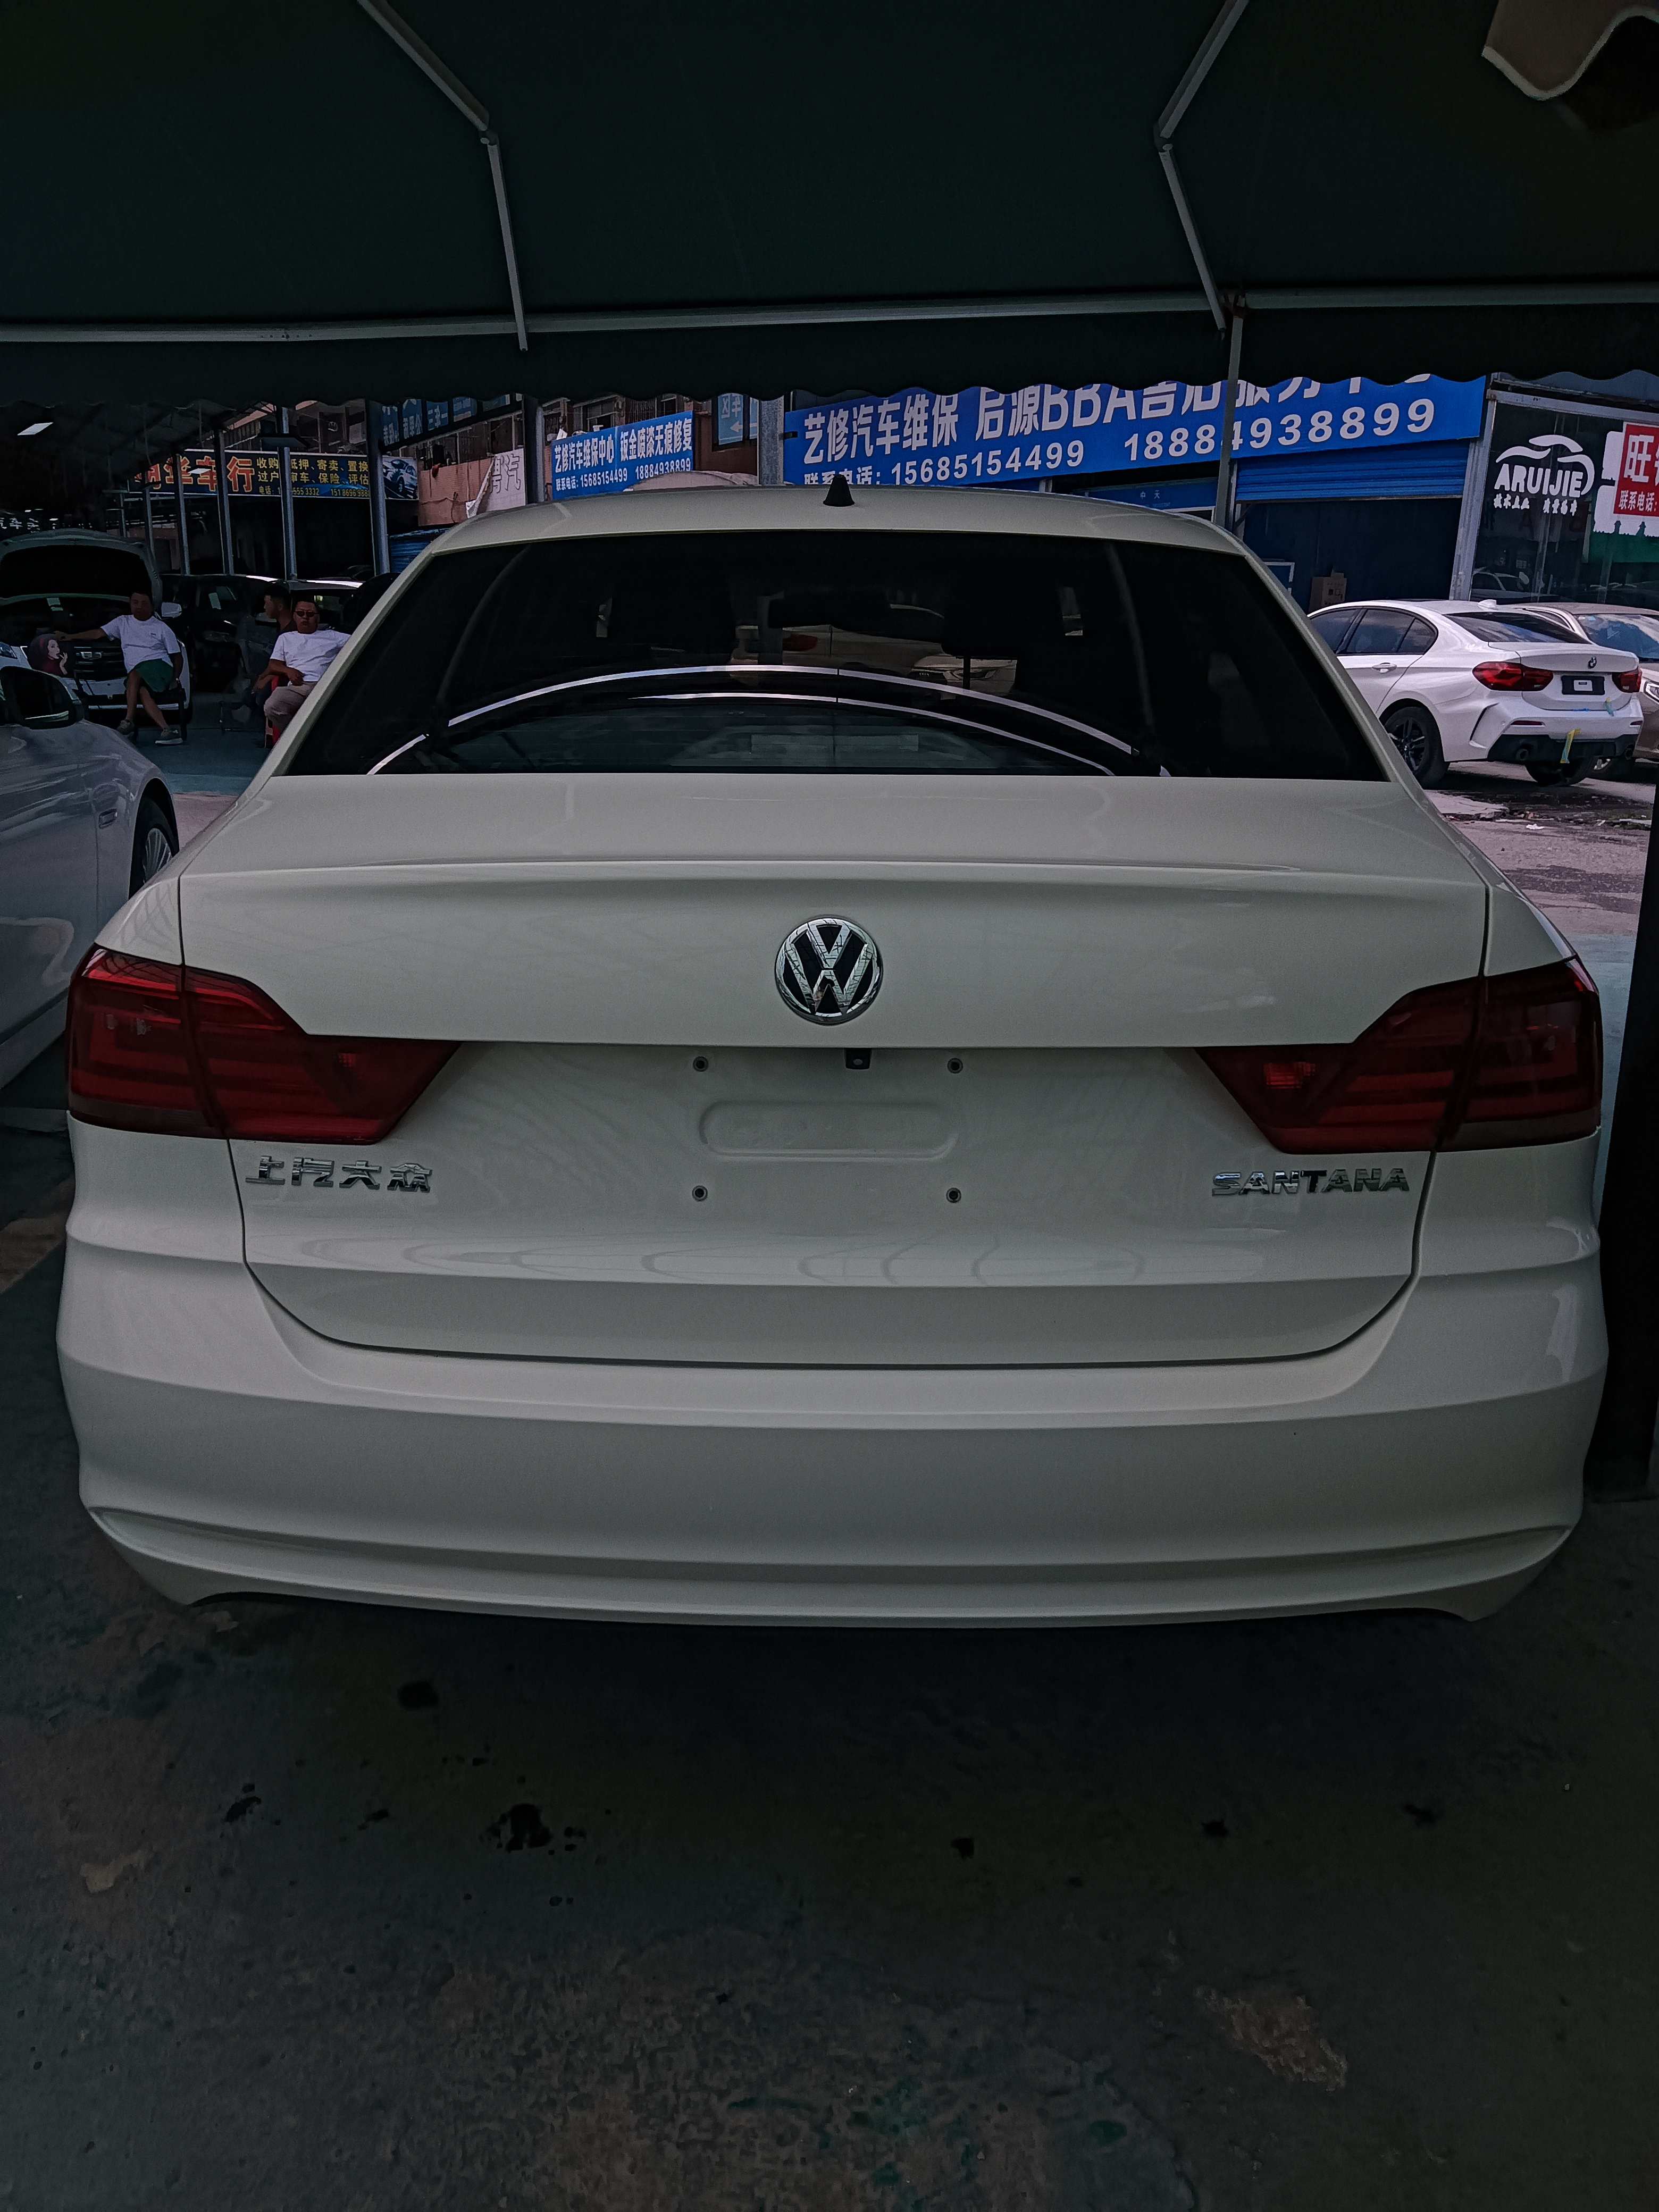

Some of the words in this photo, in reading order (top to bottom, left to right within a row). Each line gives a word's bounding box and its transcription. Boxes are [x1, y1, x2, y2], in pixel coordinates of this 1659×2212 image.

[803, 393, 958, 464] 艺修汽车维保
[975, 373, 1431, 441] 启源BBA售
[555, 433, 614, 473] 艺修汽车维保中心
[620, 418, 692, 462] 钣金喷漆无痕修复
[891, 440, 1084, 485] 15685154499
[1124, 398, 1435, 461] 18884938899
[580, 467, 628, 488] 15685154499
[1494, 463, 1583, 498] ARUIJIE
[245, 1155, 433, 1193] 上汽大众
[1212, 1168, 1410, 1196] SANTANA
